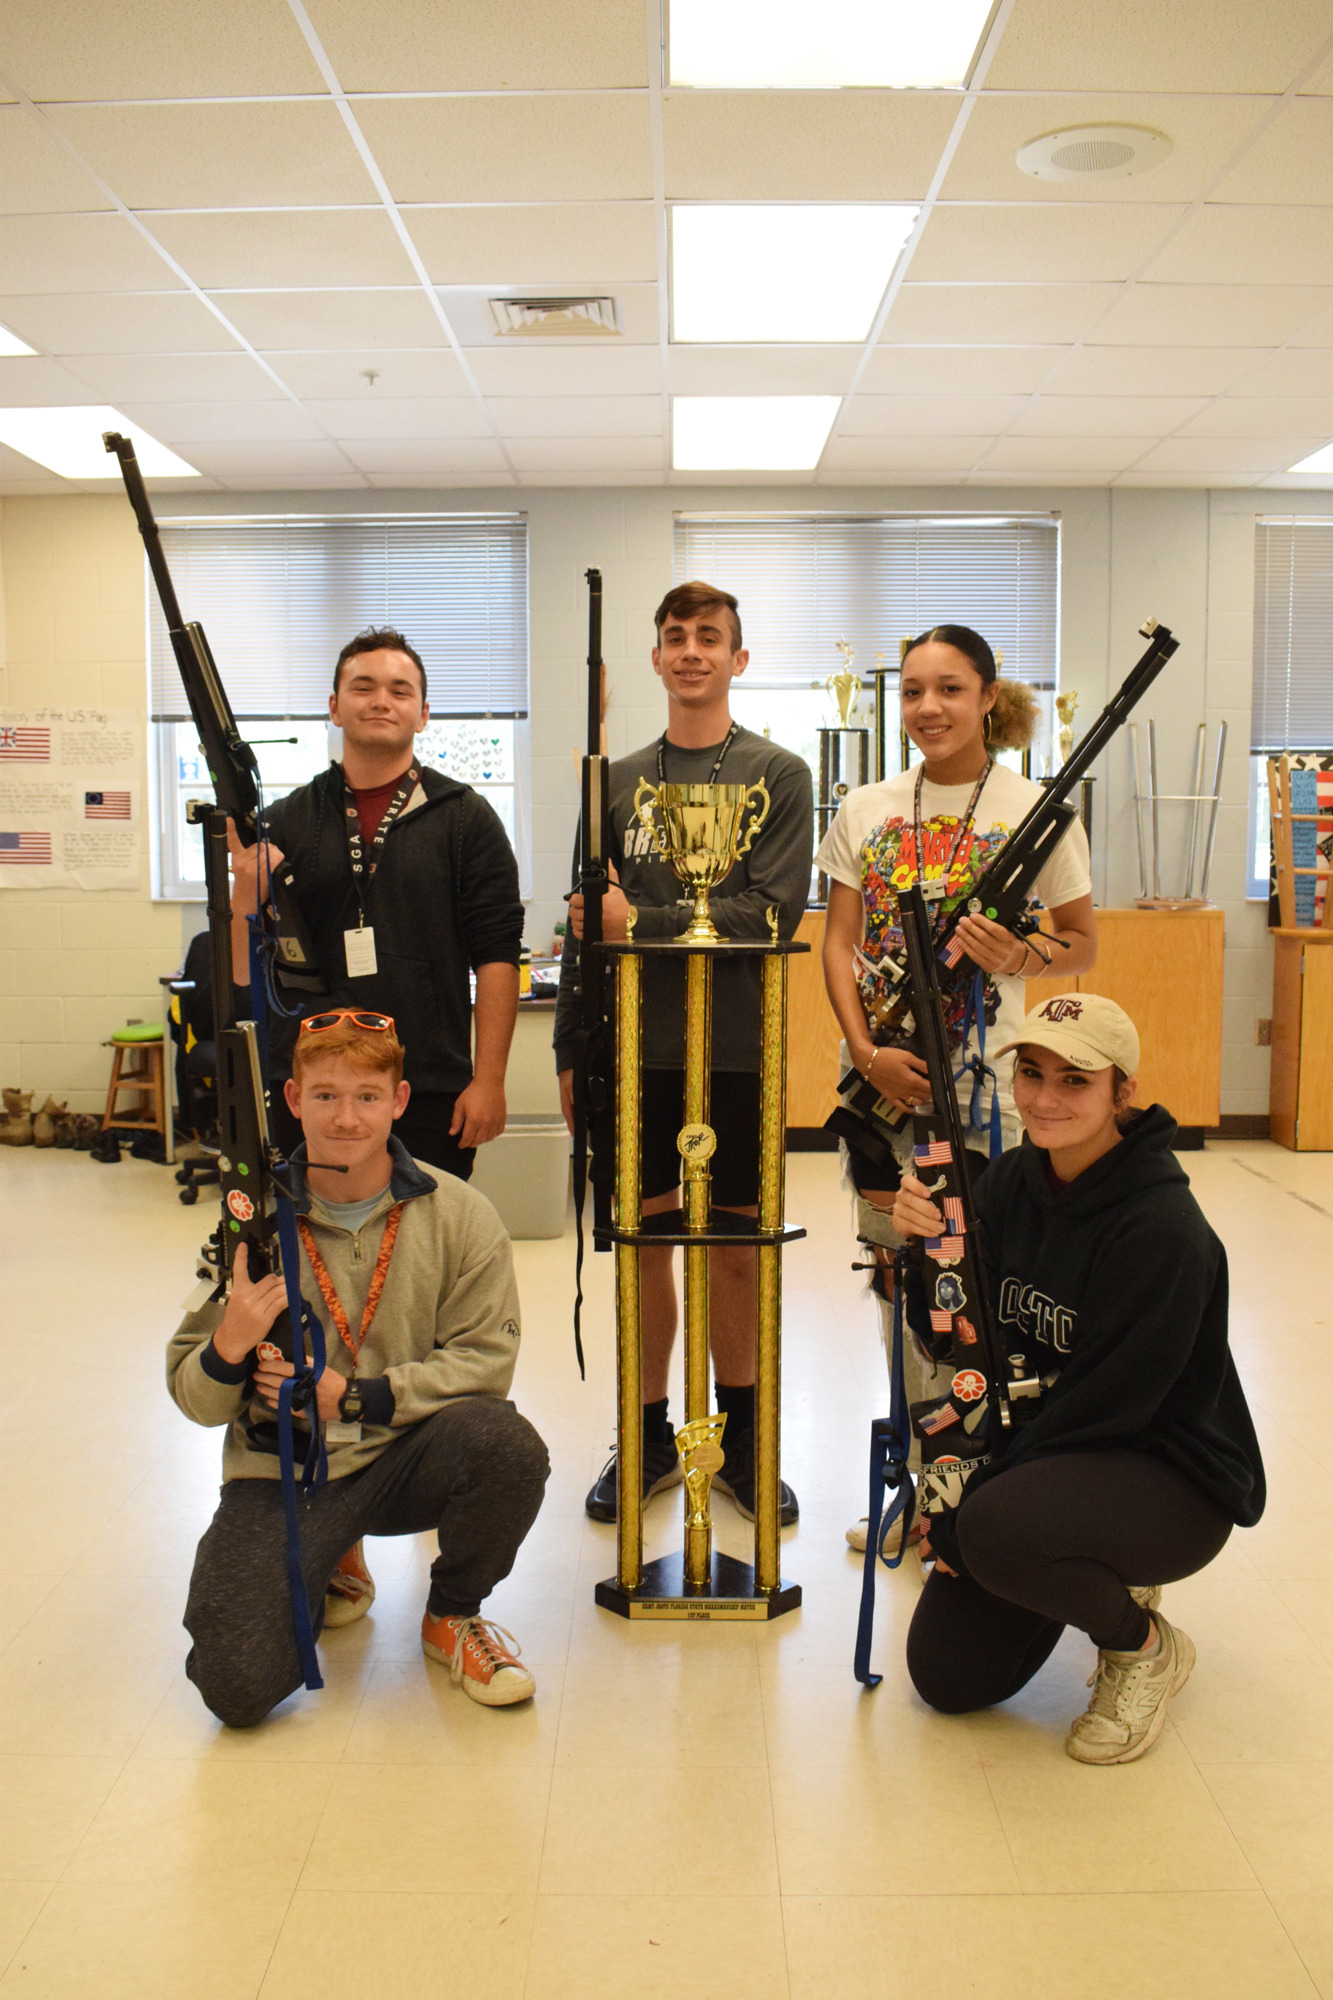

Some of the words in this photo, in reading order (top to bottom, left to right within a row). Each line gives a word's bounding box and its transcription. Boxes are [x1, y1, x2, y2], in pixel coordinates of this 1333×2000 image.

[373, 790, 407, 844] PIRATE
[896, 830, 976, 866] MARVEL
[286, 940, 297, 958] 6
[923, 1460, 979, 1475] FRIENDS
